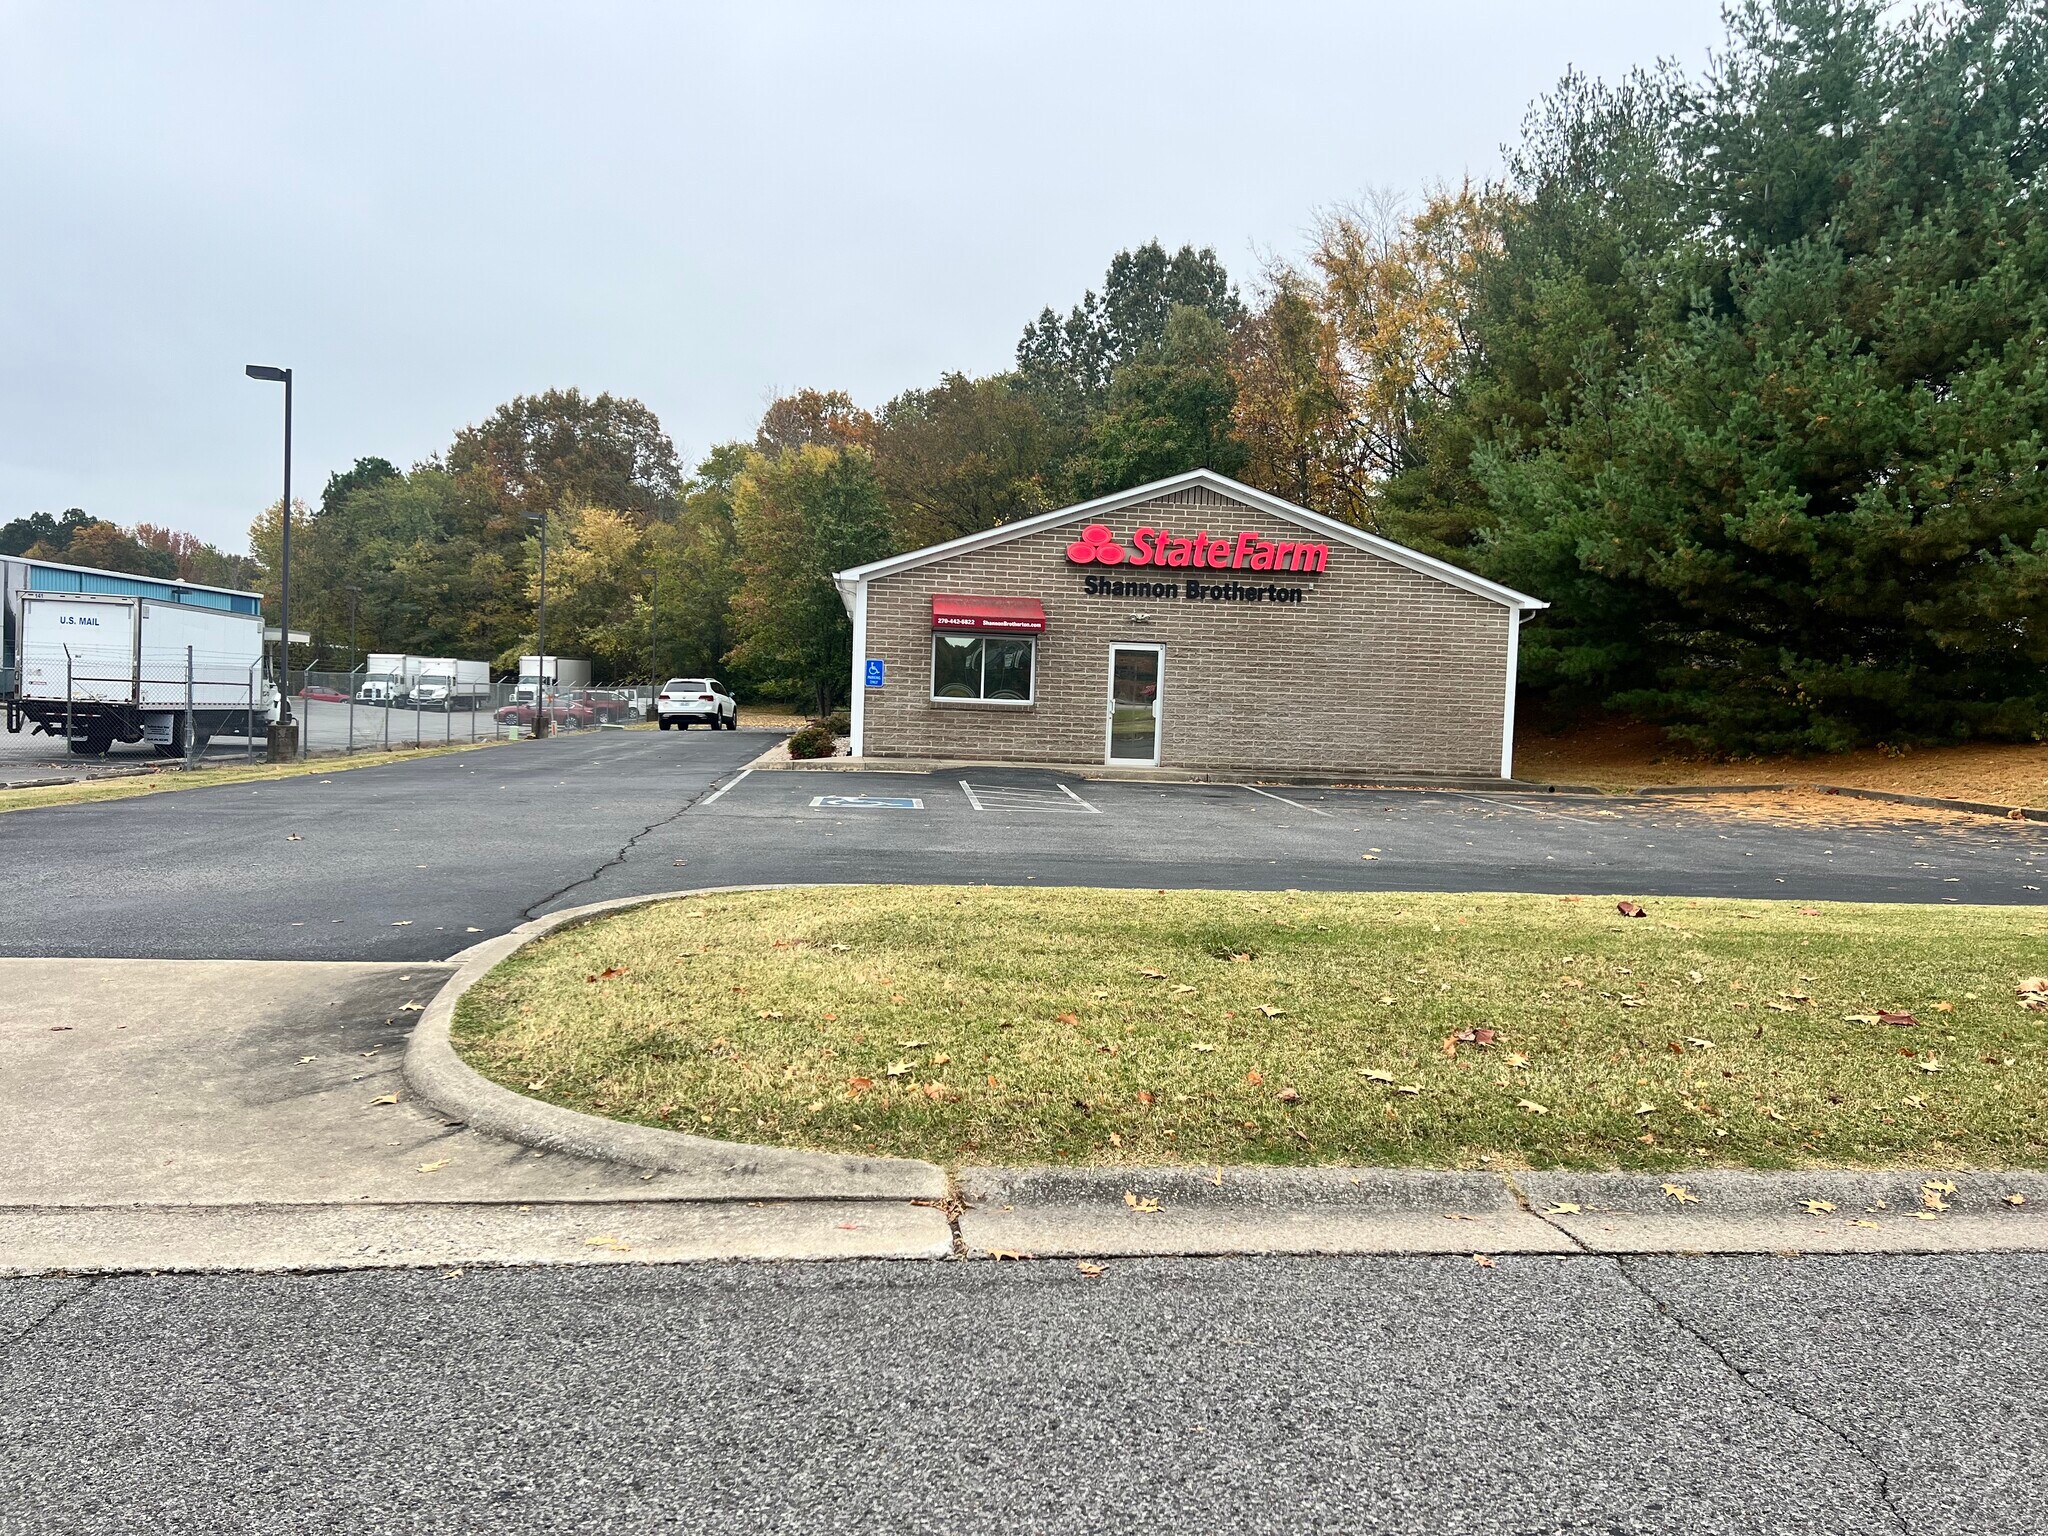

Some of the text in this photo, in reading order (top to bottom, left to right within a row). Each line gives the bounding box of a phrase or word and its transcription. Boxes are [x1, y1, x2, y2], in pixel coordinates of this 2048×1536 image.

[1084, 575, 1303, 603] Shannon Brotherton
[60, 616, 99, 626] U.S. MAIL
[982, 619, 1041, 628] ShannonBrotherton.com
